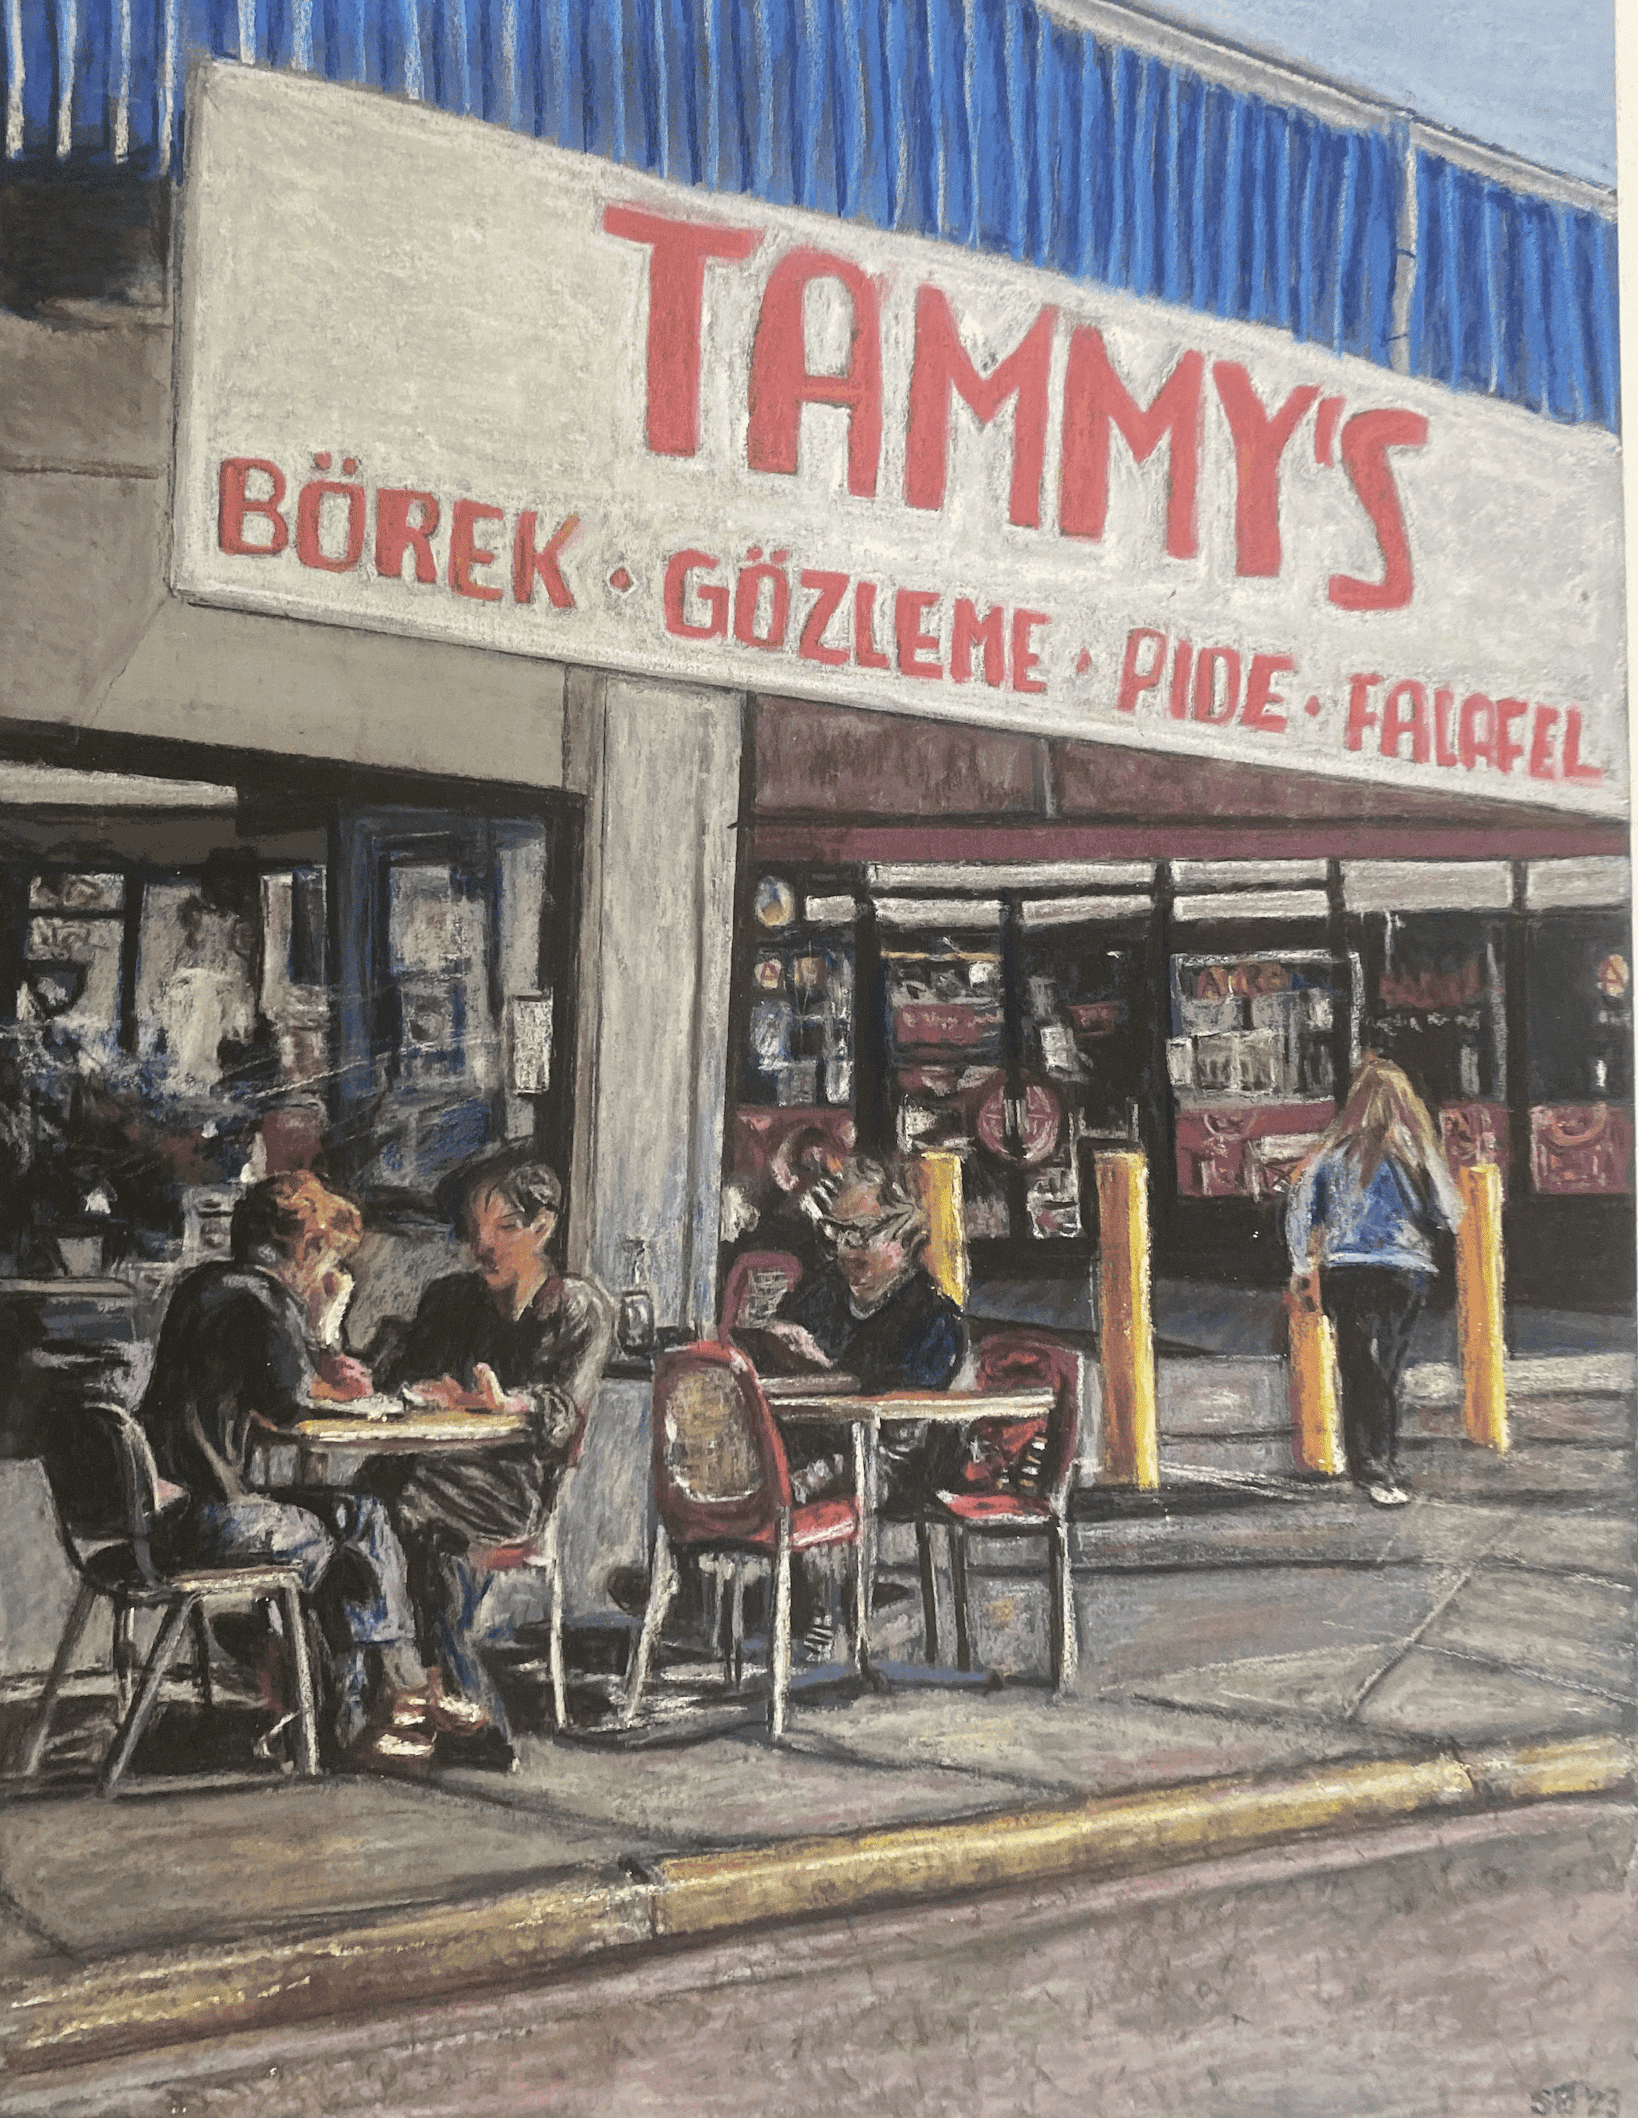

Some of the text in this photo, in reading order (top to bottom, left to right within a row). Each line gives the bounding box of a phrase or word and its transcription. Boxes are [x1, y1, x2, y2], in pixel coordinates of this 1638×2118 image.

[600, 200, 1430, 614] TAMMY'S
[219, 452, 1608, 784] BÖREK GÖZLEME PIDE FALAFEL
